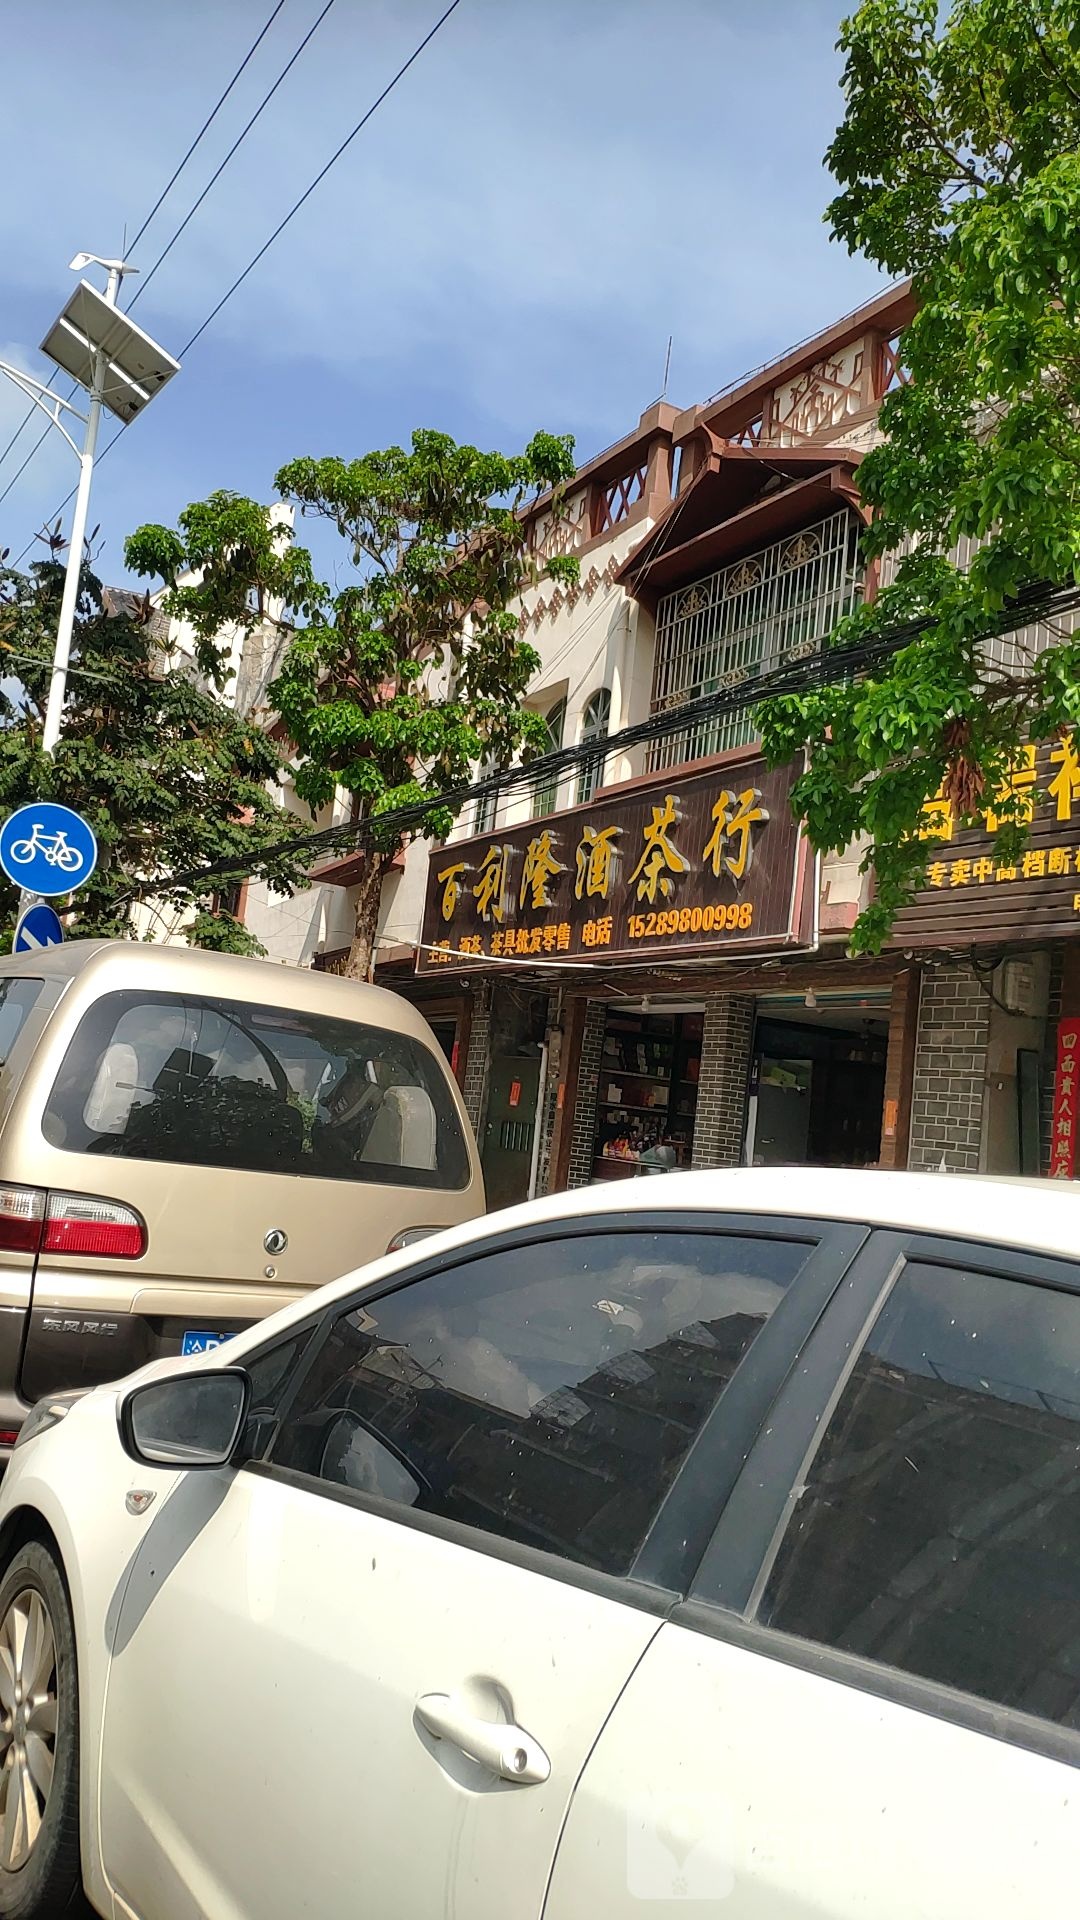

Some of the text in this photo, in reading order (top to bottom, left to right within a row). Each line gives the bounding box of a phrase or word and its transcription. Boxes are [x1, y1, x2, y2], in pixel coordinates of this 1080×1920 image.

[436, 788, 767, 923] 百利隆酒茶行
[927, 847, 1080, 888] 专卖中高档断
[581, 916, 612, 947] 电话
[627, 903, 753, 938] 15289800998
